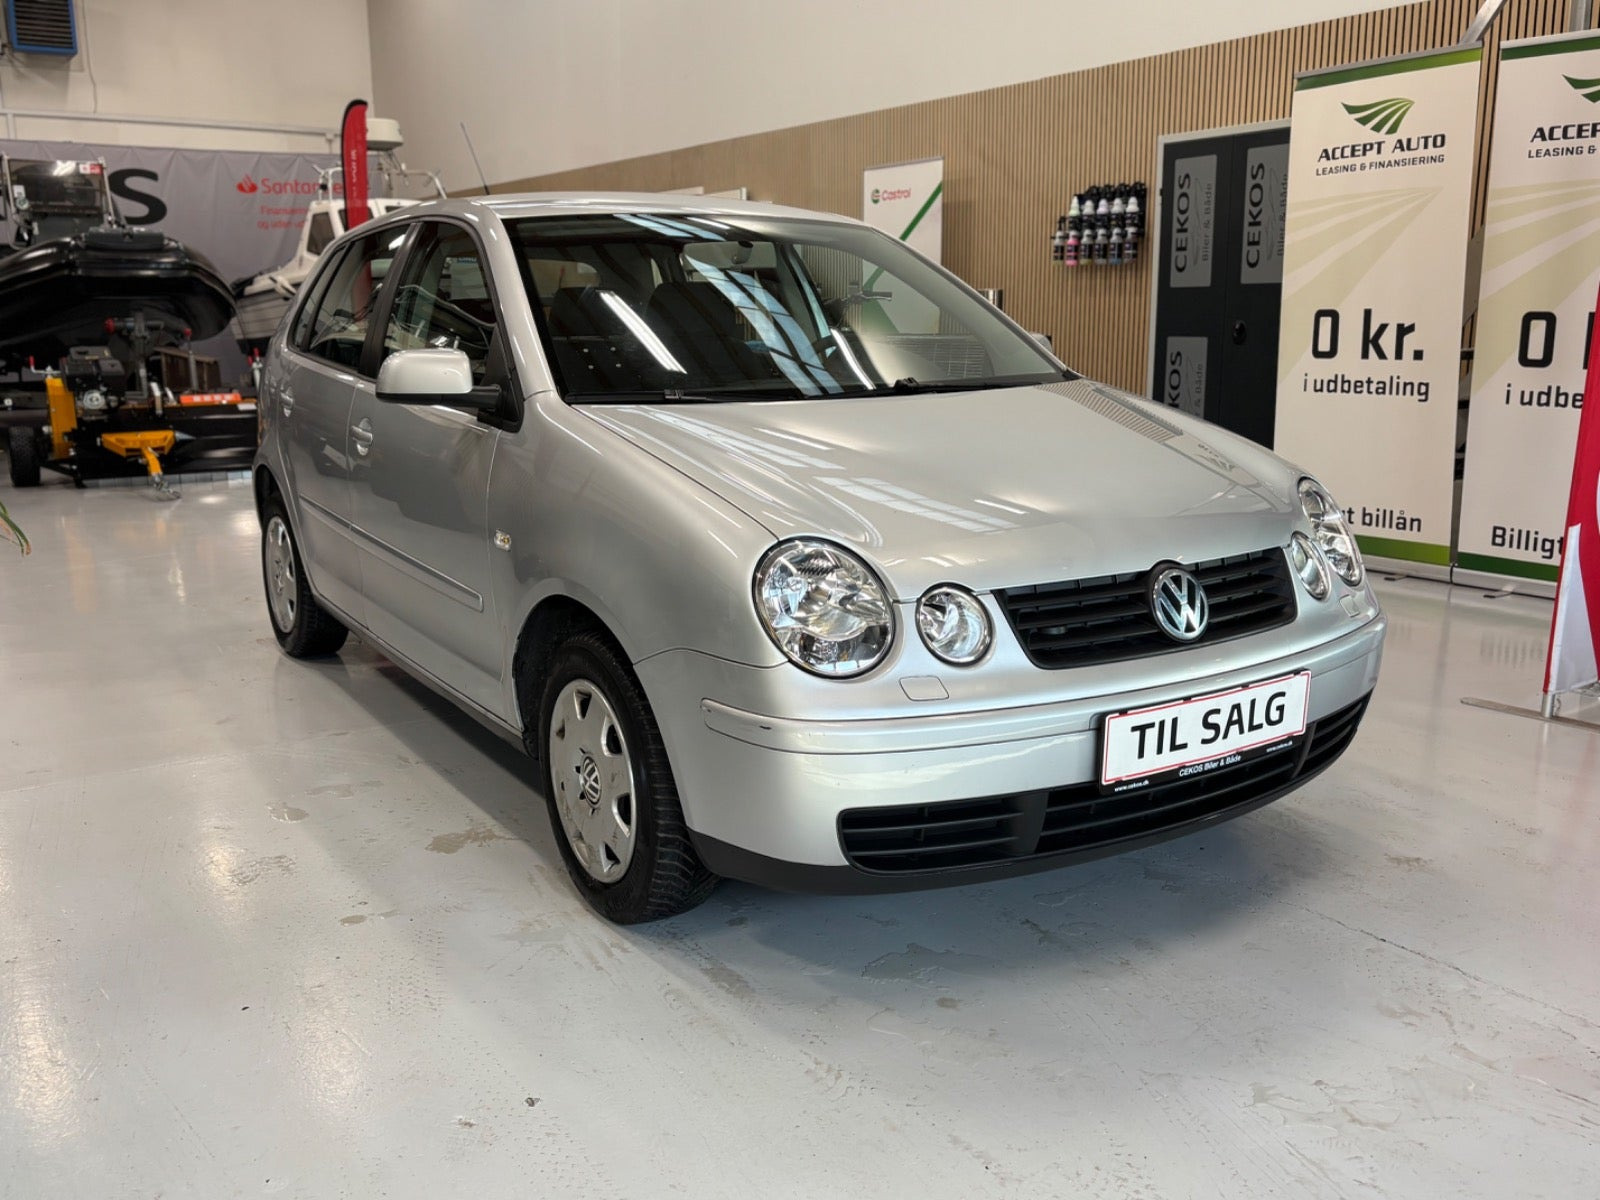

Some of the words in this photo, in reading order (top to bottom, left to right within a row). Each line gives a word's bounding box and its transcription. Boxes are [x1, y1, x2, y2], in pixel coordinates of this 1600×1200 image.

[1317, 140, 1386, 162] ACCEPT
[1391, 133, 1446, 153] AUTO
[1528, 146, 1584, 158] LEASING
[1587, 145, 1597, 154] &
[1315, 163, 1357, 176] LEASING
[1359, 162, 1367, 171] &
[1368, 154, 1445, 170] FINANSIERING
[881, 188, 912, 201] Castrol
[1174, 173, 1191, 273] CEKOS
[1246, 163, 1265, 269] CEKOS
[1311, 308, 1340, 359] 0
[1360, 308, 1424, 361] kr.
[1518, 311, 1557, 368] 0
[1303, 373, 1309, 393] i
[1312, 374, 1430, 402] udbetaling
[1505, 382, 1511, 405] i
[1361, 506, 1422, 532] billån
[1131, 716, 1188, 760] TIL
[1200, 691, 1286, 745] SALG
[1178, 764, 1203, 777] CEKOS
[1203, 760, 1219, 771] Biler
[1225, 754, 1242, 765] Både
